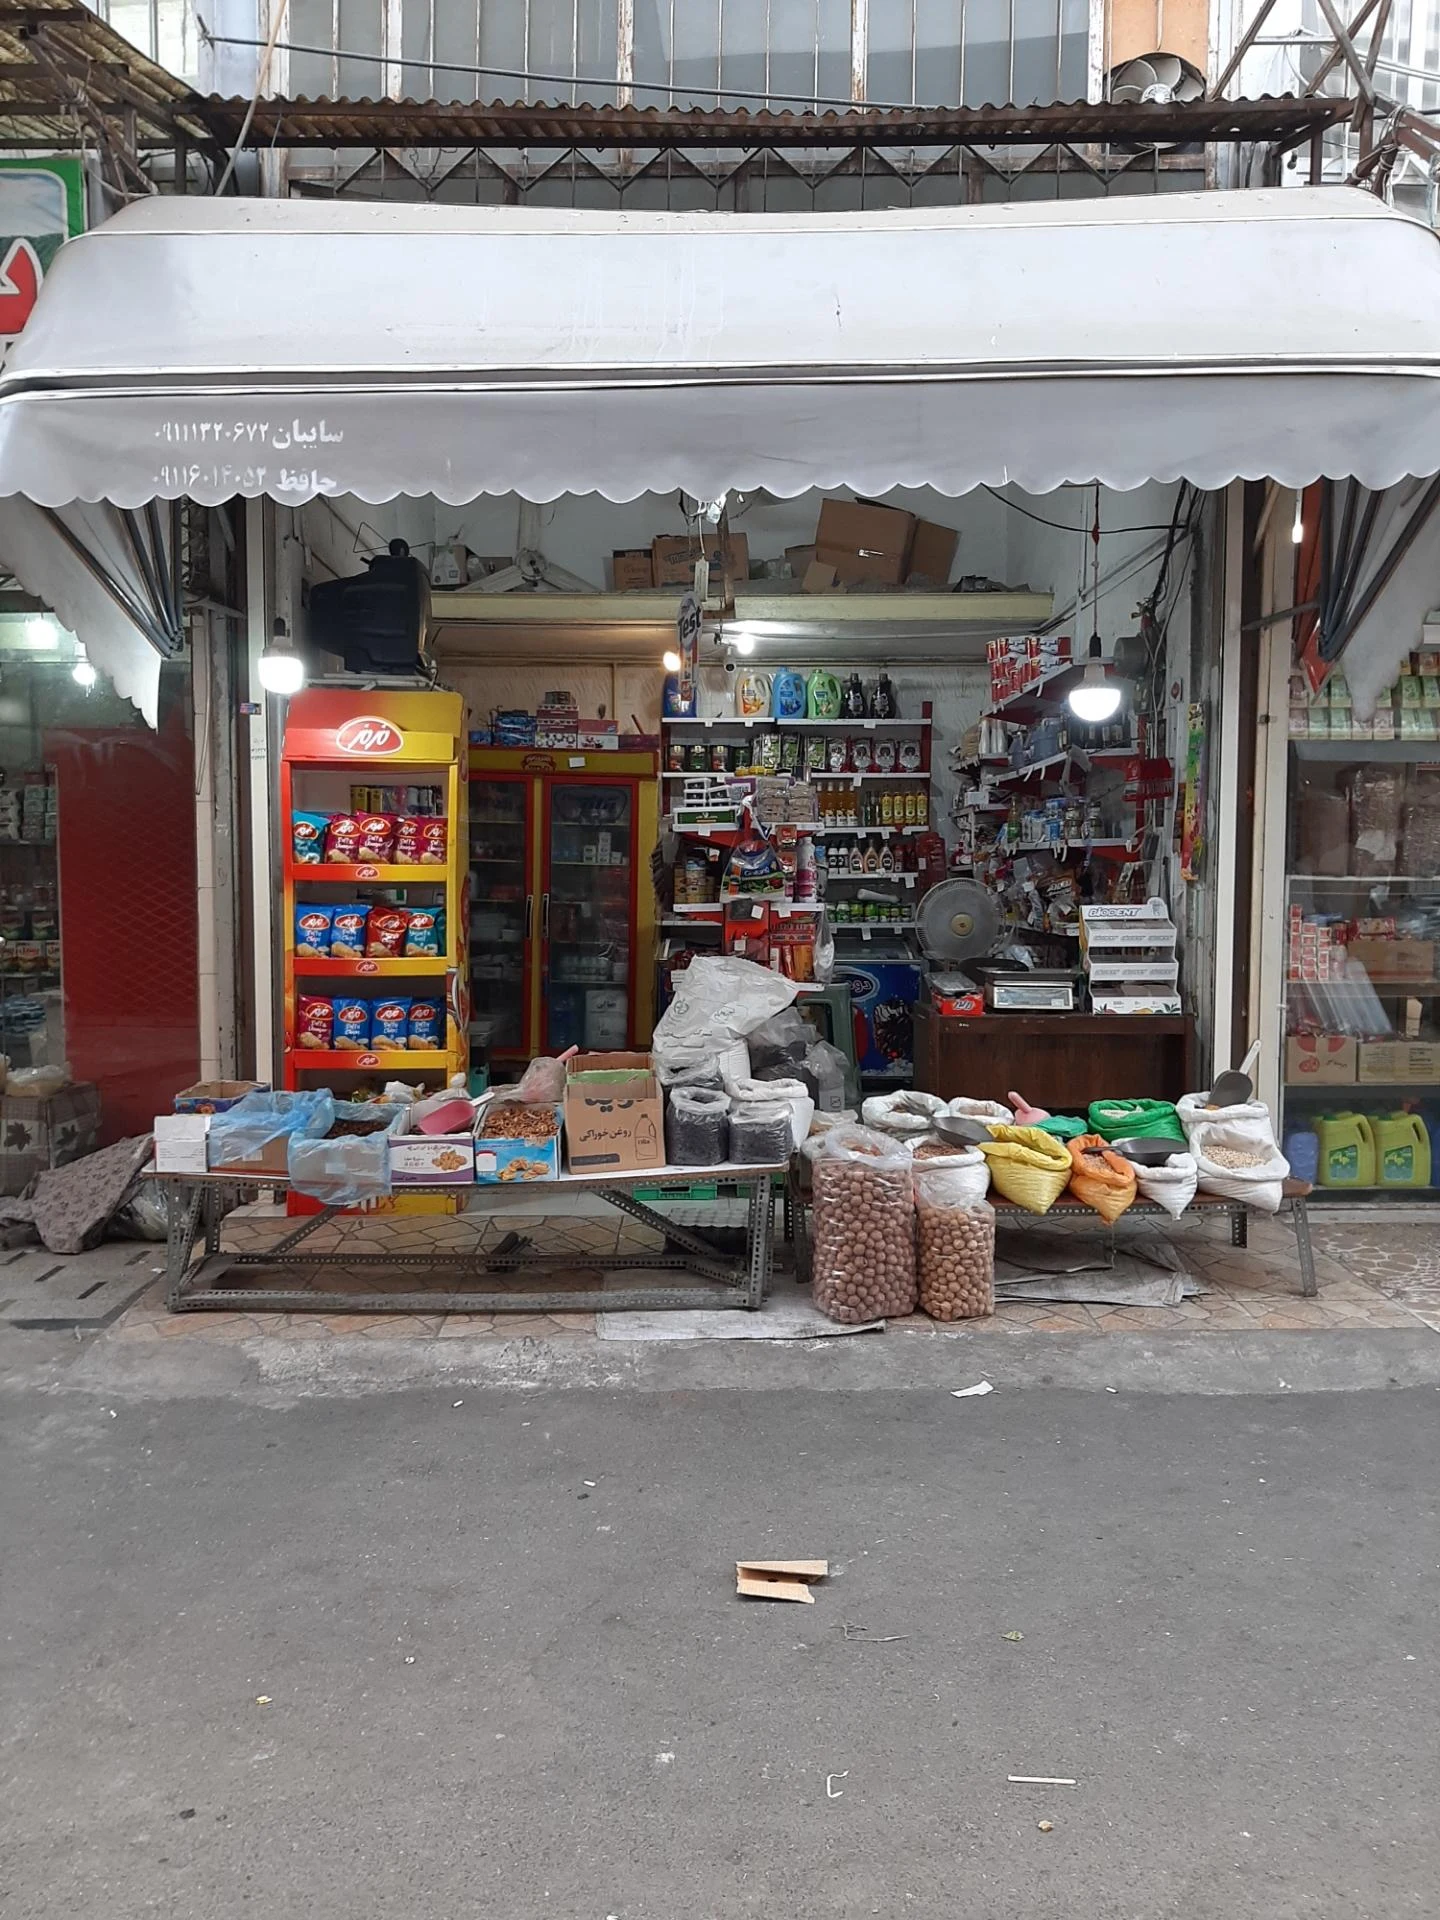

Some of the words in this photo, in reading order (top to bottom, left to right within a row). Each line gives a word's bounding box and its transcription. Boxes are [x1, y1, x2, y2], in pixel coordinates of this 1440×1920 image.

[272, 418, 344, 449] سایبان
[275, 467, 337, 493] حافظ
[678, 605, 702, 642] Test
[347, 722, 391, 751] مزمز
[579, 1127, 609, 1142] خوراکی
[609, 1126, 632, 1139] روغن
